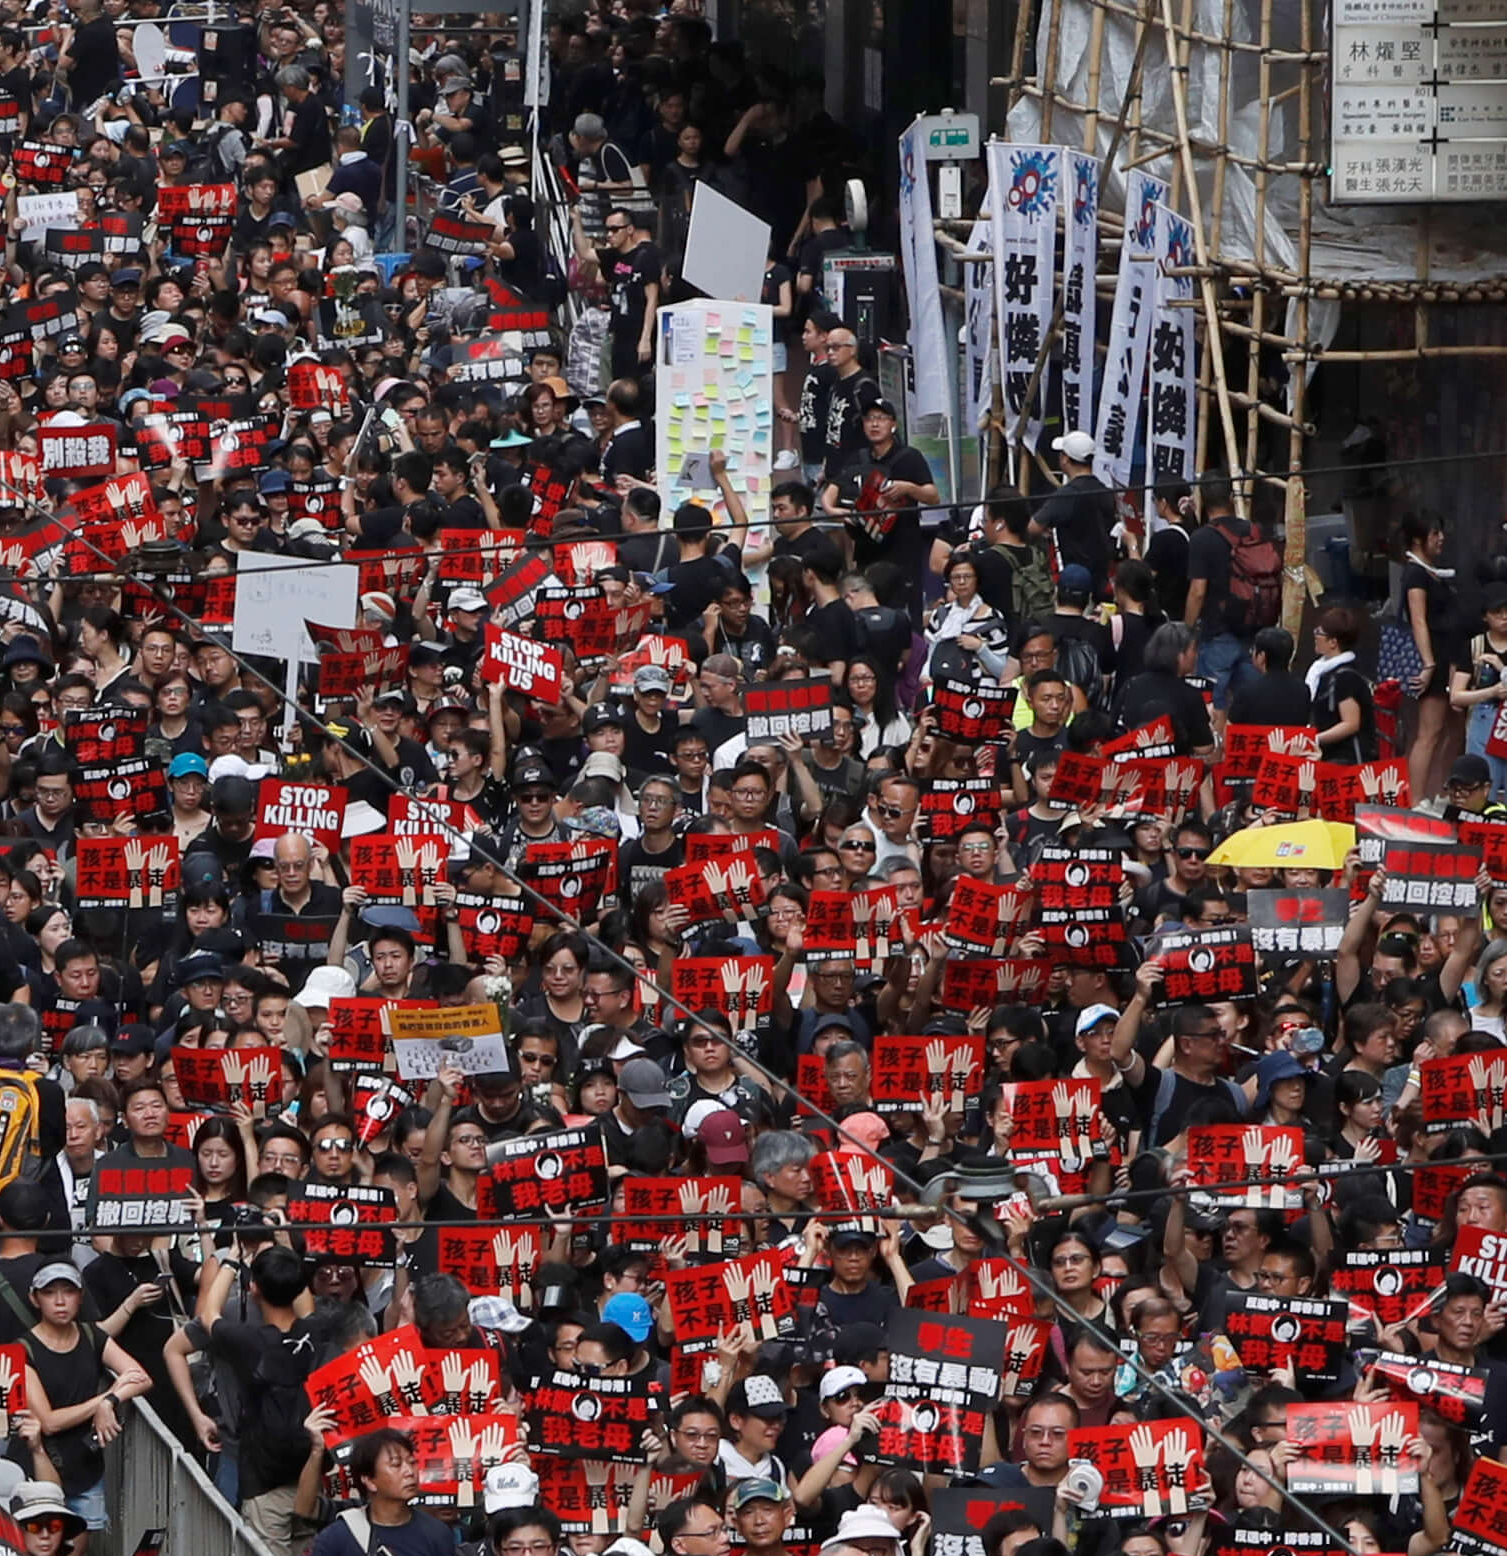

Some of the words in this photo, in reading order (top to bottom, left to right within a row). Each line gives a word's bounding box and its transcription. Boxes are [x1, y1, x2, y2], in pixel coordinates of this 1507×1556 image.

[42, 435, 110, 469] 別殺我
[499, 631, 545, 658] STOP
[489, 644, 557, 684] KILLING
[508, 667, 537, 691] US
[279, 785, 330, 809] STOP
[264, 806, 338, 831] KILLING
